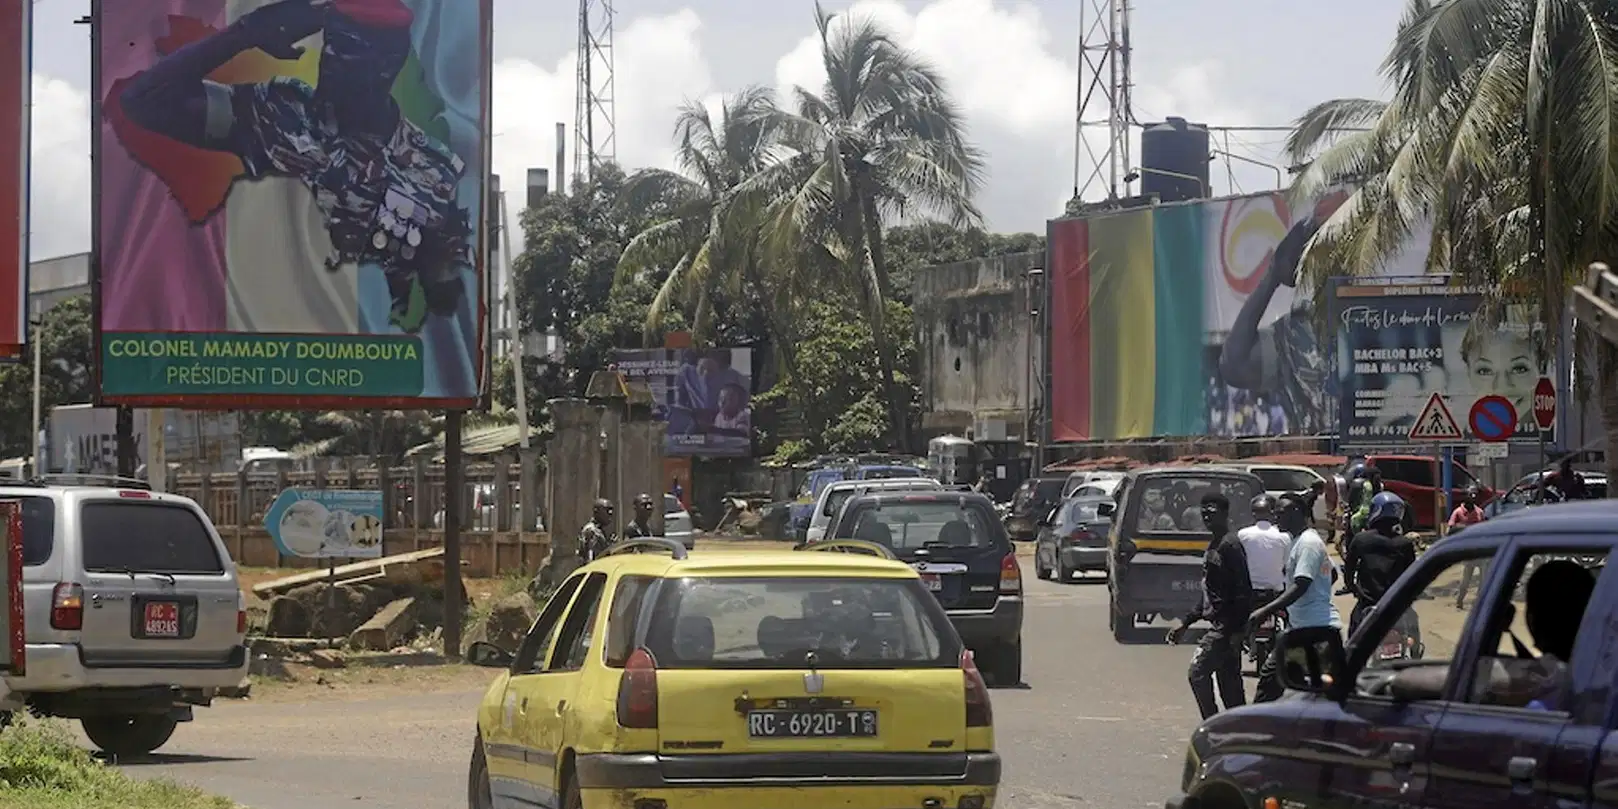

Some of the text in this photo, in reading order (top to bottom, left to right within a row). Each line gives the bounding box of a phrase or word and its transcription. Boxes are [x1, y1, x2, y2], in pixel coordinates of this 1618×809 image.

[108, 339, 418, 361] COLONEL MAMADY DOUMBOUYA
[1354, 347, 1443, 360] BACHELOR BAC+3
[166, 362, 364, 387] PRÉSIDENT DU CNRD
[1354, 362, 1379, 374] MBA
[1398, 361, 1433, 373] BAC+5
[1534, 395, 1556, 411] STOP
